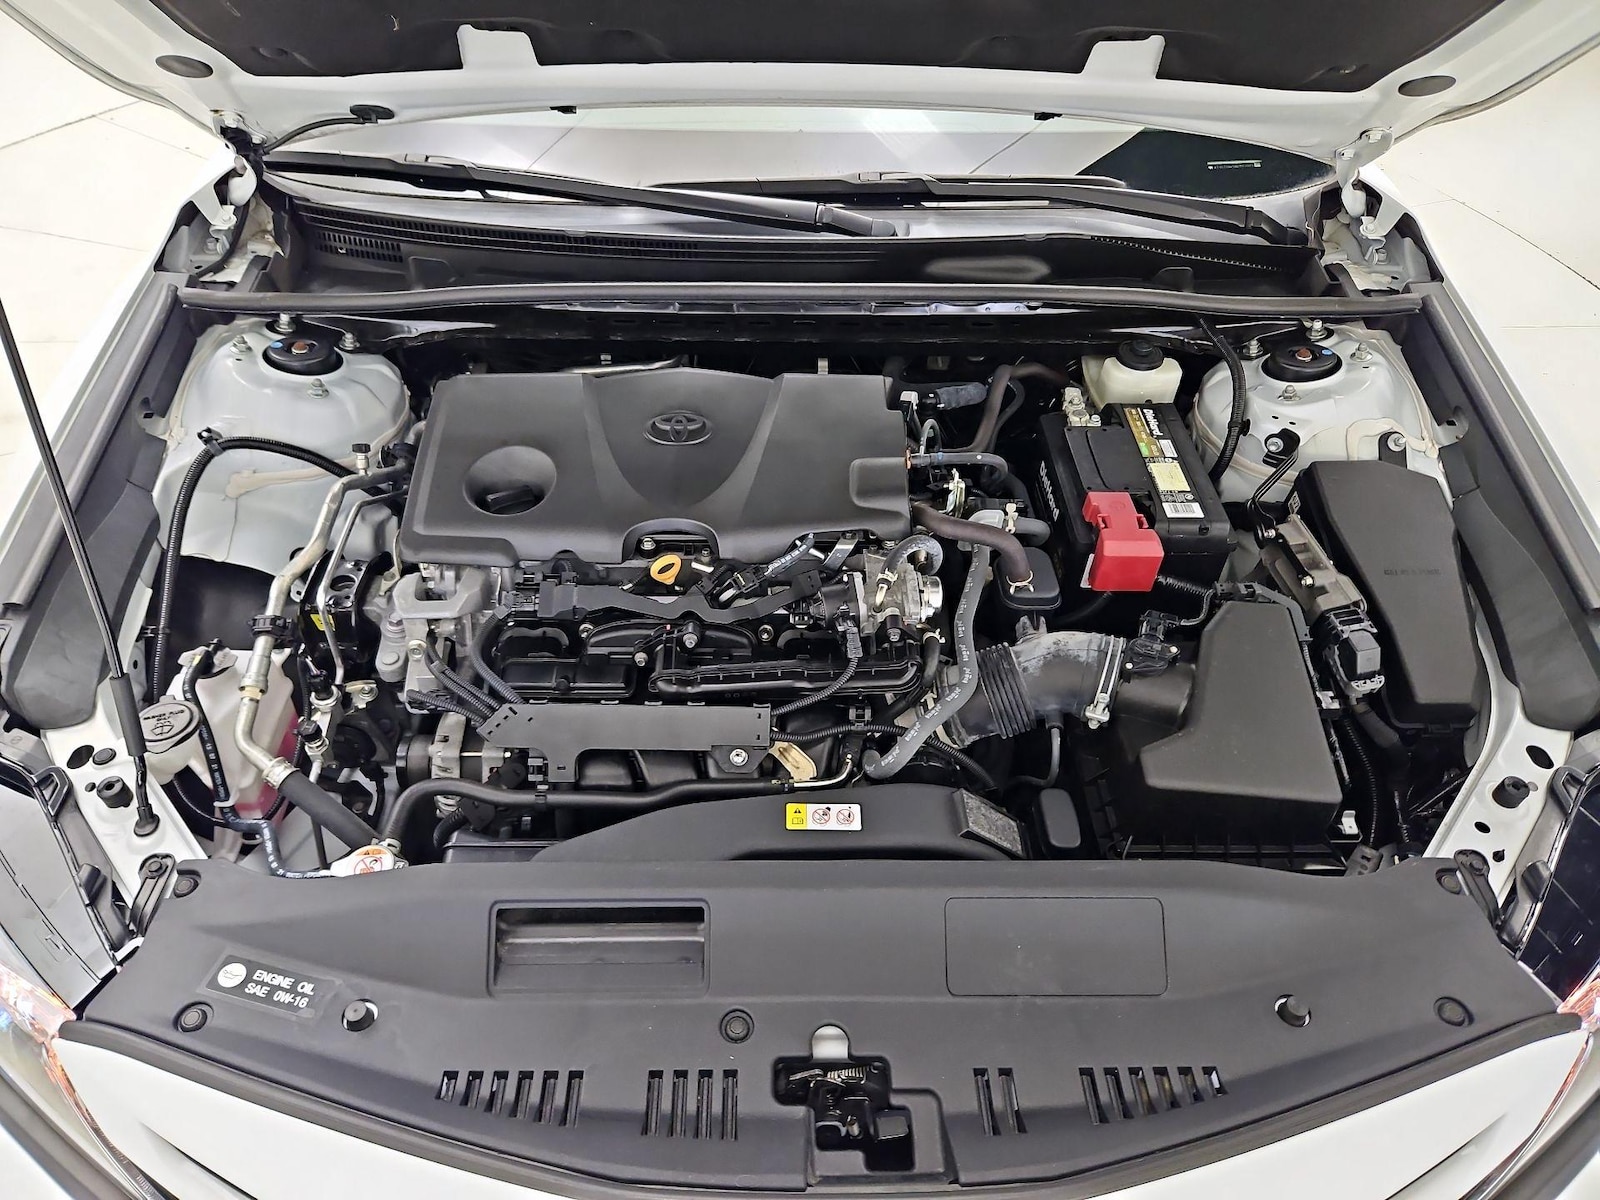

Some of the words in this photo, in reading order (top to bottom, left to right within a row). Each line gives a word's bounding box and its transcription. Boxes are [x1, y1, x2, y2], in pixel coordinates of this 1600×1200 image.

[1142, 408, 1164, 437] DieHard
[1039, 460, 1060, 522] DieHard
[244, 982, 270, 998] SAE
[272, 990, 309, 1008] 0W-16
[252, 969, 295, 989] ENGINE
[296, 981, 315, 996] OIL
